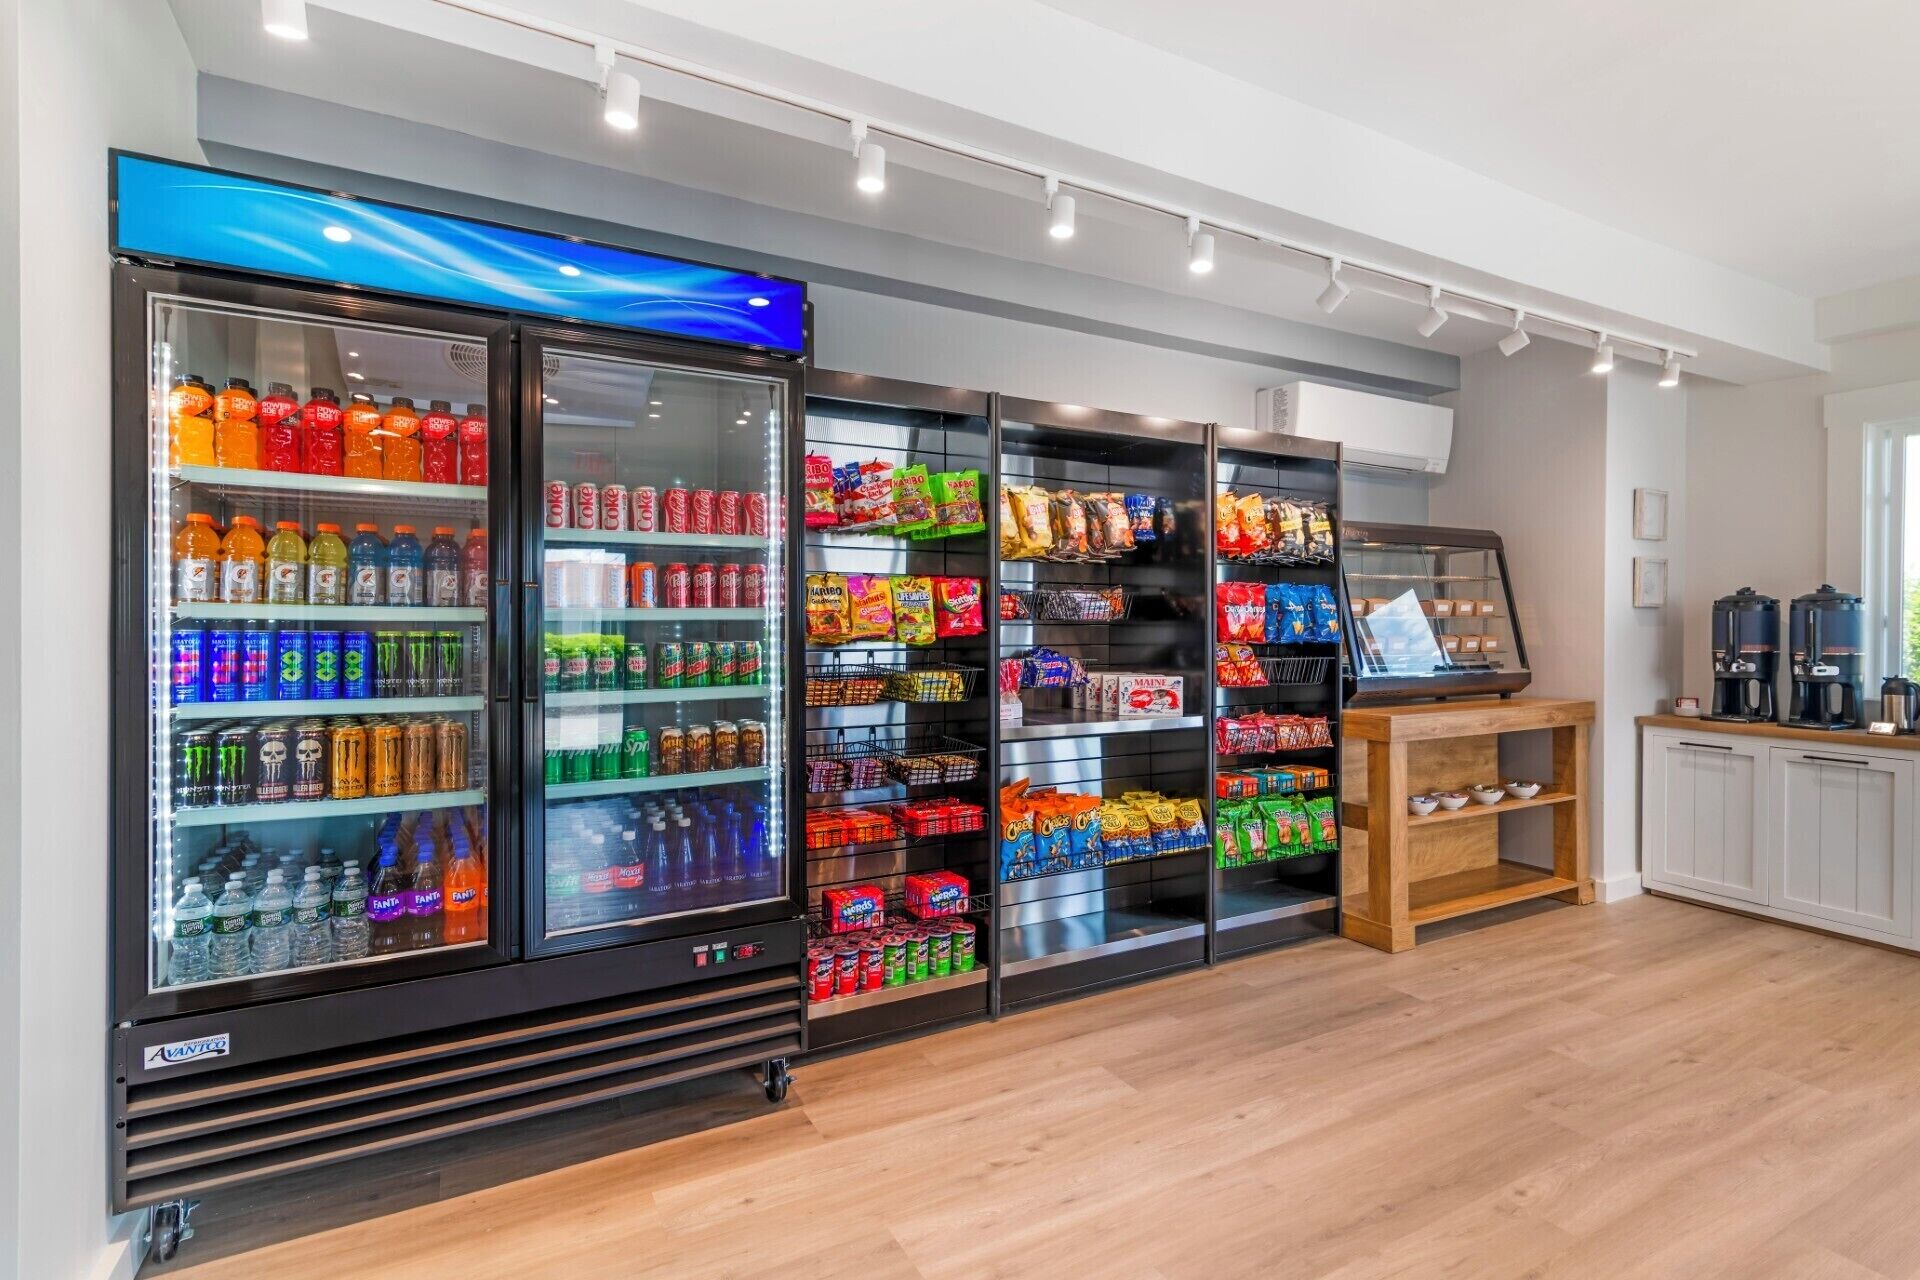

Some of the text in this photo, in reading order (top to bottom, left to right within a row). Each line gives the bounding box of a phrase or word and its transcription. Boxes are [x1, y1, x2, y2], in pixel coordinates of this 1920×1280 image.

[893, 475, 924, 487] HARIBO
[546, 484, 563, 528] Coke
[577, 486, 594, 530] Coke
[604, 488, 619, 530] Coke
[637, 490, 653, 531] Coke
[810, 586, 842, 596] HARIBO
[1134, 679, 1167, 687] MAINE
[662, 739, 684, 749] MUG
[214, 783, 251, 792] MONSTER
[415, 891, 440, 904] FANTA
[452, 889, 476, 901] FANTA
[373, 897, 400, 909] FANTA
[261, 911, 282, 920] Poland
[297, 908, 318, 918] Poland
[298, 912, 318, 922] Spring
[181, 919, 203, 929] Poland
[223, 916, 244, 925] Poland
[261, 916, 282, 926] Spring
[183, 924, 204, 935] Spring
[148, 1040, 227, 1062] AVANTCO
